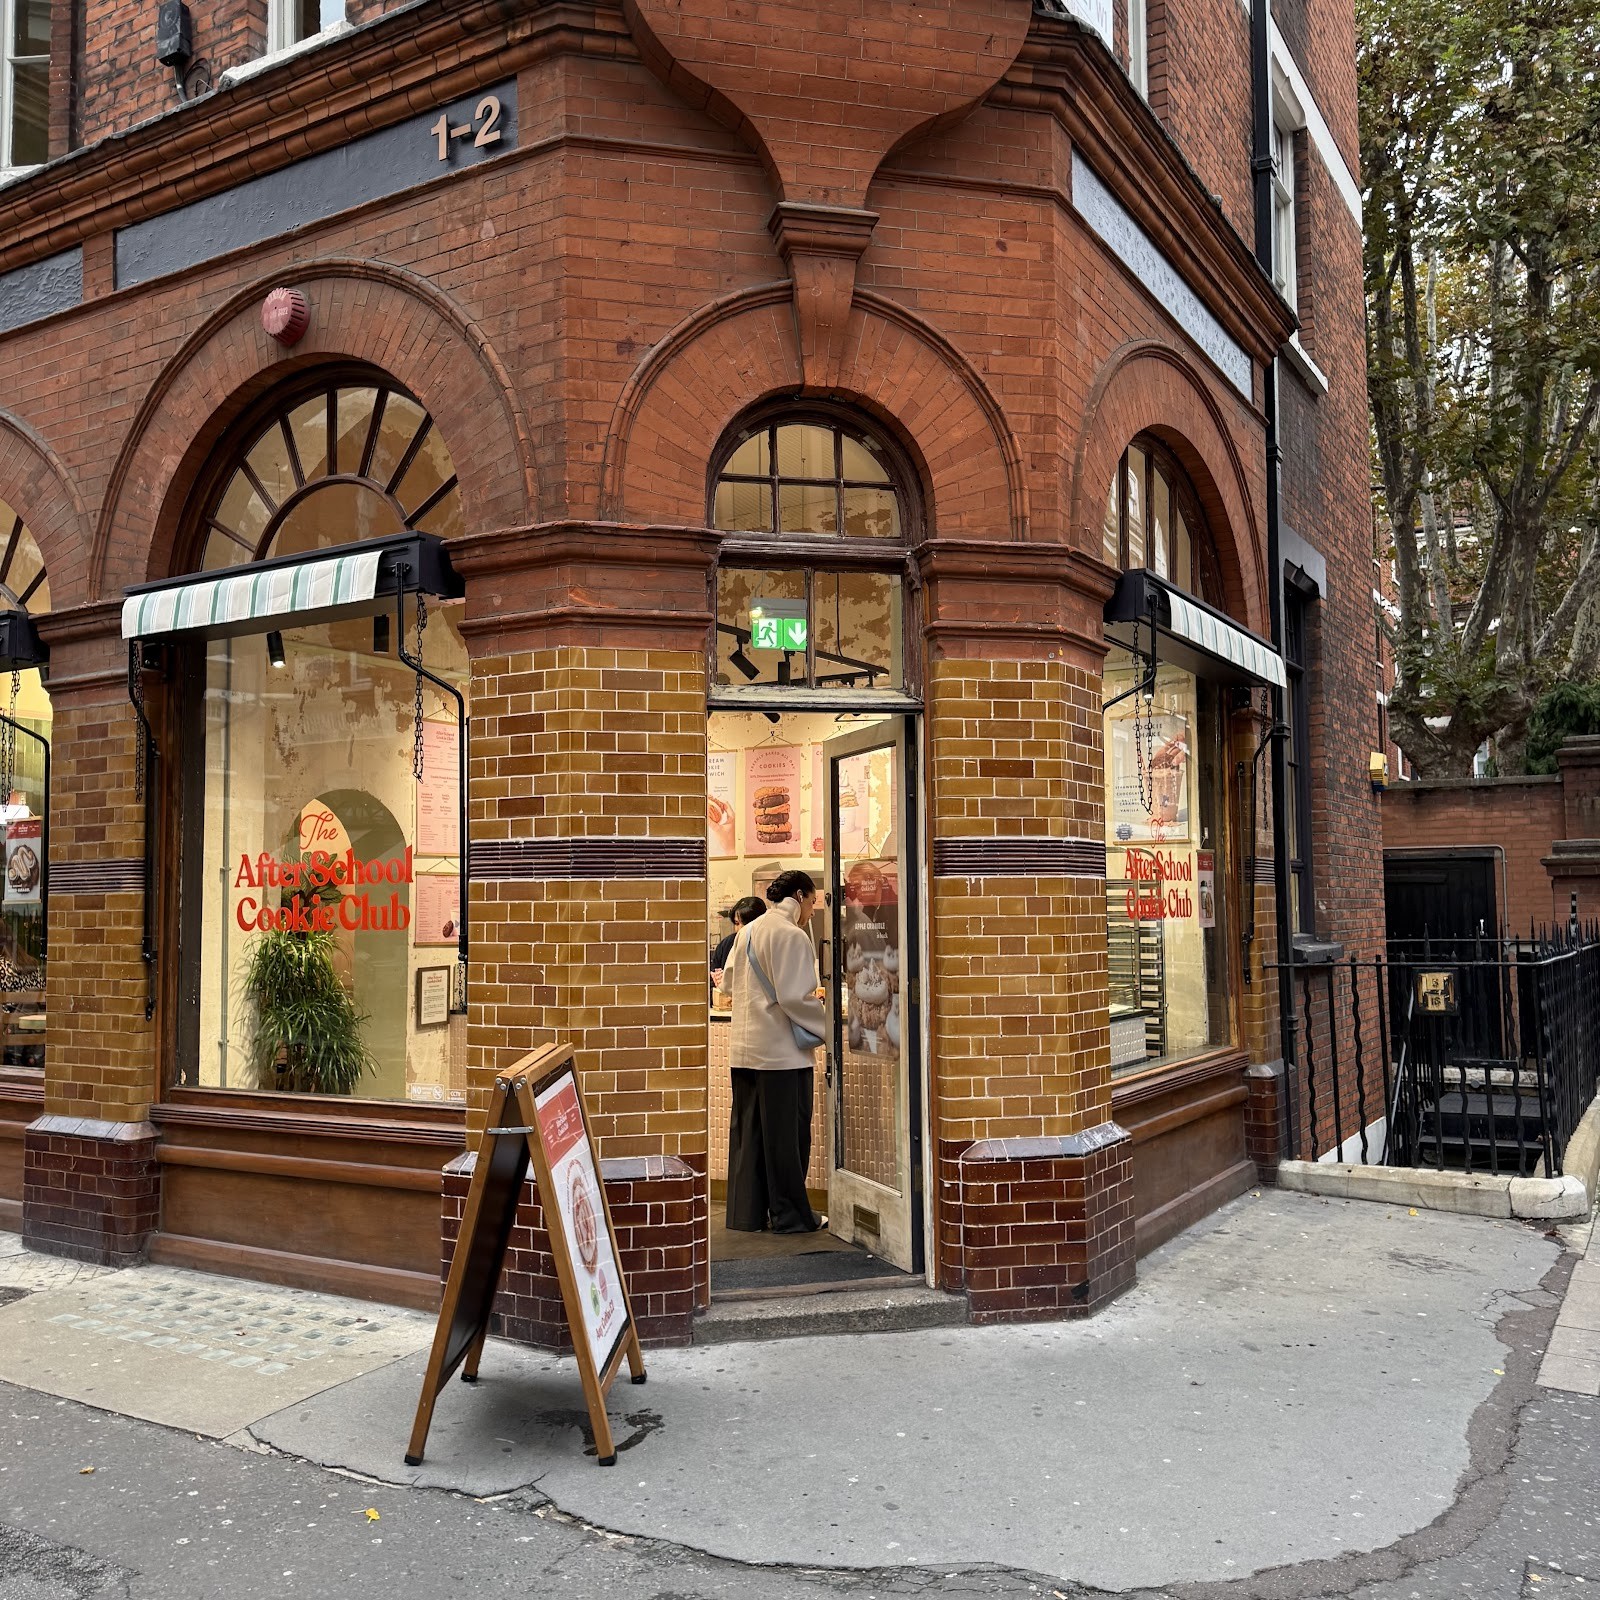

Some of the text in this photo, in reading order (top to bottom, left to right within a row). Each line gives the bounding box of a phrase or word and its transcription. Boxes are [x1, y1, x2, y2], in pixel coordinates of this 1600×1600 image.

[430, 95, 501, 161] 1-2
[299, 811, 338, 850] The
[1151, 817, 1166, 848] The
[234, 845, 414, 888] After School
[1125, 848, 1192, 882] After School
[236, 894, 336, 932] Cookie
[338, 892, 411, 930] Club
[1126, 887, 1192, 920] Cookie Club
